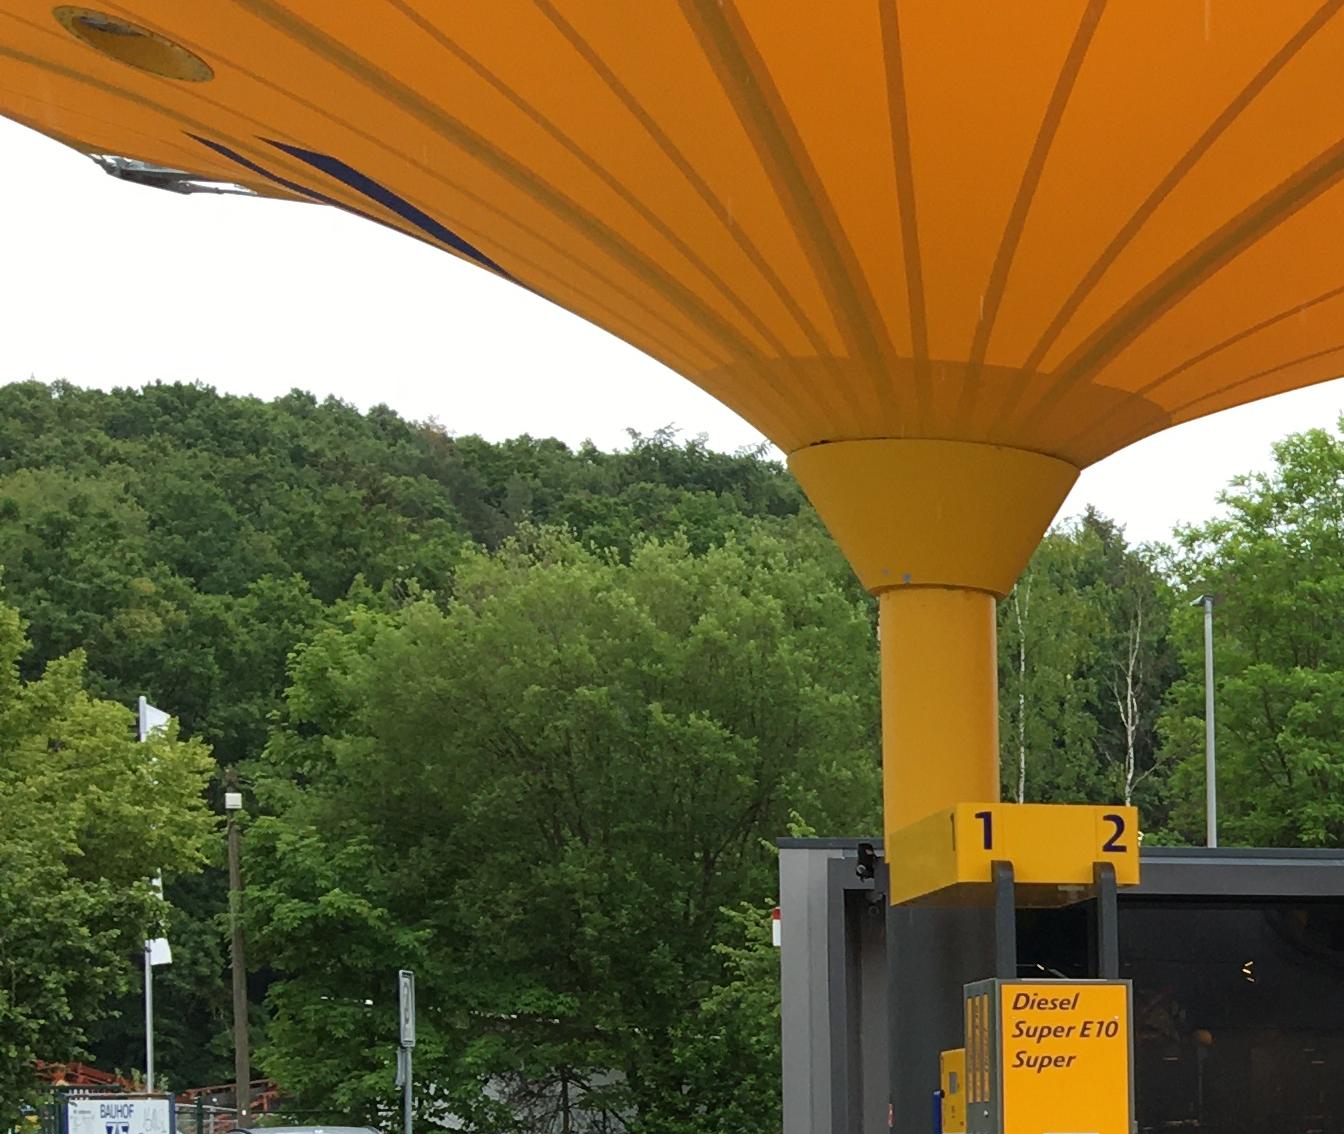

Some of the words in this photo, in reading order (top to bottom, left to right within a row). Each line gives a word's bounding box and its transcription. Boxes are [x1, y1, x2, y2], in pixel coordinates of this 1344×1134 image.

[974, 811, 993, 850] 1
[1102, 814, 1127, 852] 2
[1012, 992, 1080, 1011] Diesel
[1011, 1020, 1076, 1044] Super
[1079, 1020, 1120, 1038] E10
[1011, 1050, 1077, 1074] Super
[100, 1104, 134, 1119] BAUHOF
